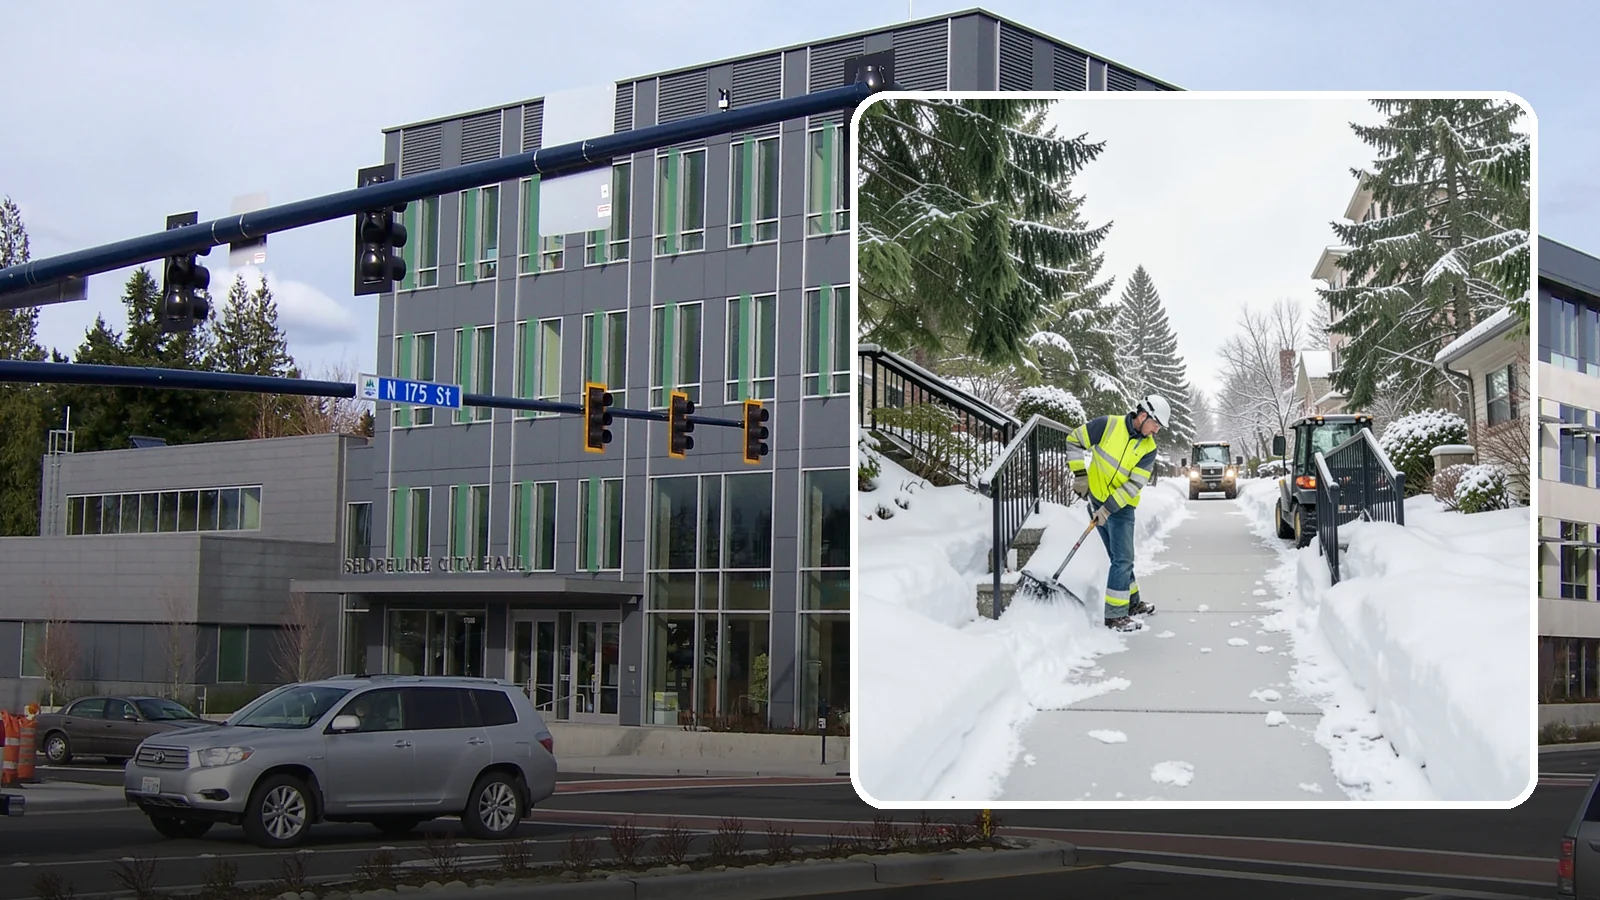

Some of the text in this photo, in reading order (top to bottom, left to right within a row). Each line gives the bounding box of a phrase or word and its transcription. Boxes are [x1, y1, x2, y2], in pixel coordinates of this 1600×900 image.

[387, 380, 451, 406] N 175 St
[344, 556, 526, 574] SHORELINE CITY HALL
